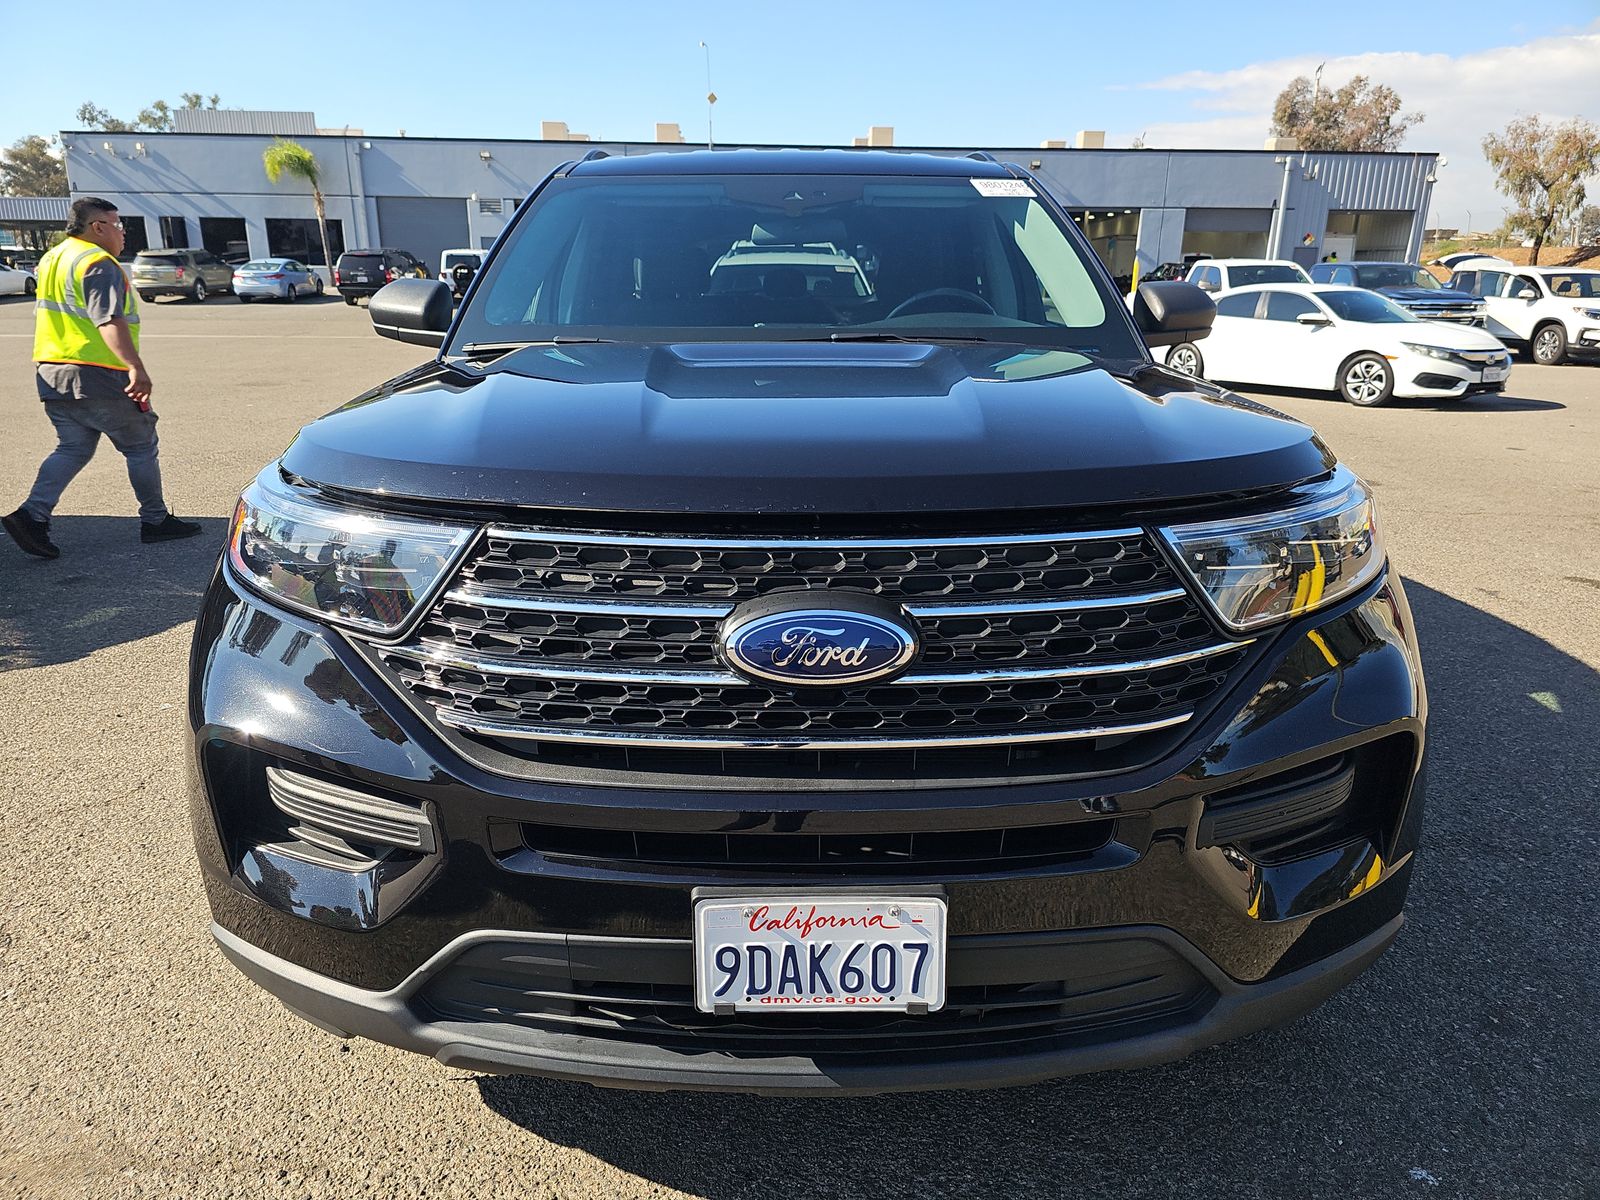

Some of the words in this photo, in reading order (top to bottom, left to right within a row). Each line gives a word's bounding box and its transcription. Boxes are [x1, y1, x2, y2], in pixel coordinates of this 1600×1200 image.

[771, 626, 869, 667] Ford
[749, 905, 900, 939] California
[714, 942, 929, 997] 9DAK607
[760, 995, 883, 1004] dmv.ca.gov
